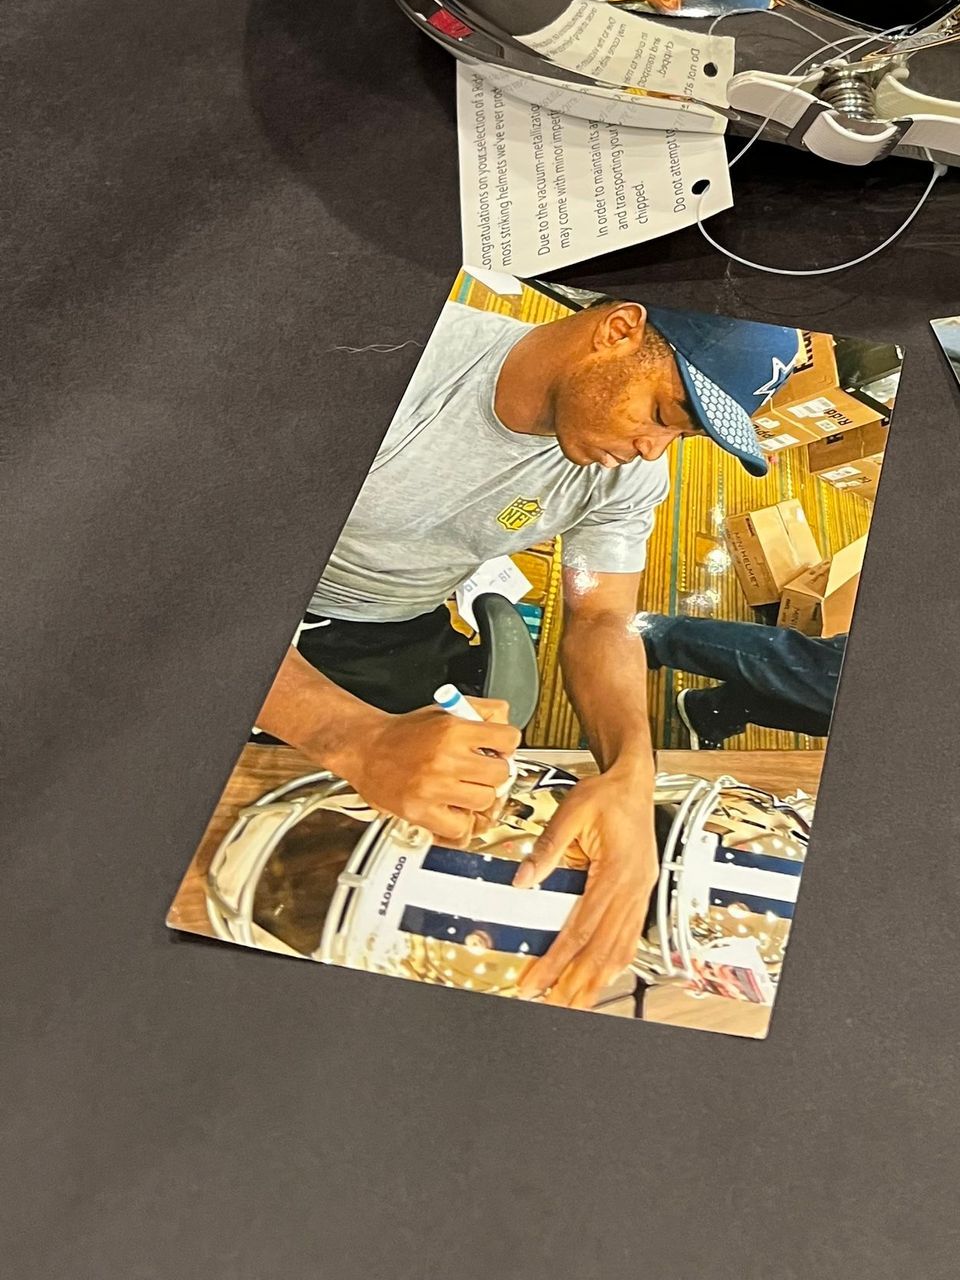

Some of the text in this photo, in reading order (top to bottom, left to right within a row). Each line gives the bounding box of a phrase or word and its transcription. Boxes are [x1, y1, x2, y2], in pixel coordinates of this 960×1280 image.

[494, 110, 505, 130] ever
[472, 110, 488, 154] selection
[608, 128, 624, 151] your
[477, 154, 492, 176] your
[551, 145, 565, 173] minor
[588, 144, 604, 185] maintain
[666, 138, 681, 177] attempt
[478, 175, 489, 190] on
[494, 159, 509, 200] helmets
[552, 174, 567, 197] with
[608, 150, 627, 210] transporting
[671, 177, 684, 196] not
[594, 187, 605, 198] to
[631, 180, 651, 225] chipped.
[534, 202, 549, 220] the
[557, 197, 569, 225] come
[593, 198, 607, 225] order
[673, 197, 687, 214] Do
[496, 200, 513, 238] striking
[537, 220, 550, 232] to
[613, 210, 629, 231] and
[559, 227, 573, 249] may
[596, 225, 609, 238] In
[499, 239, 513, 267] most
[537, 232, 551, 256] Due
[378, 856, 407, 916] COWBOYS
